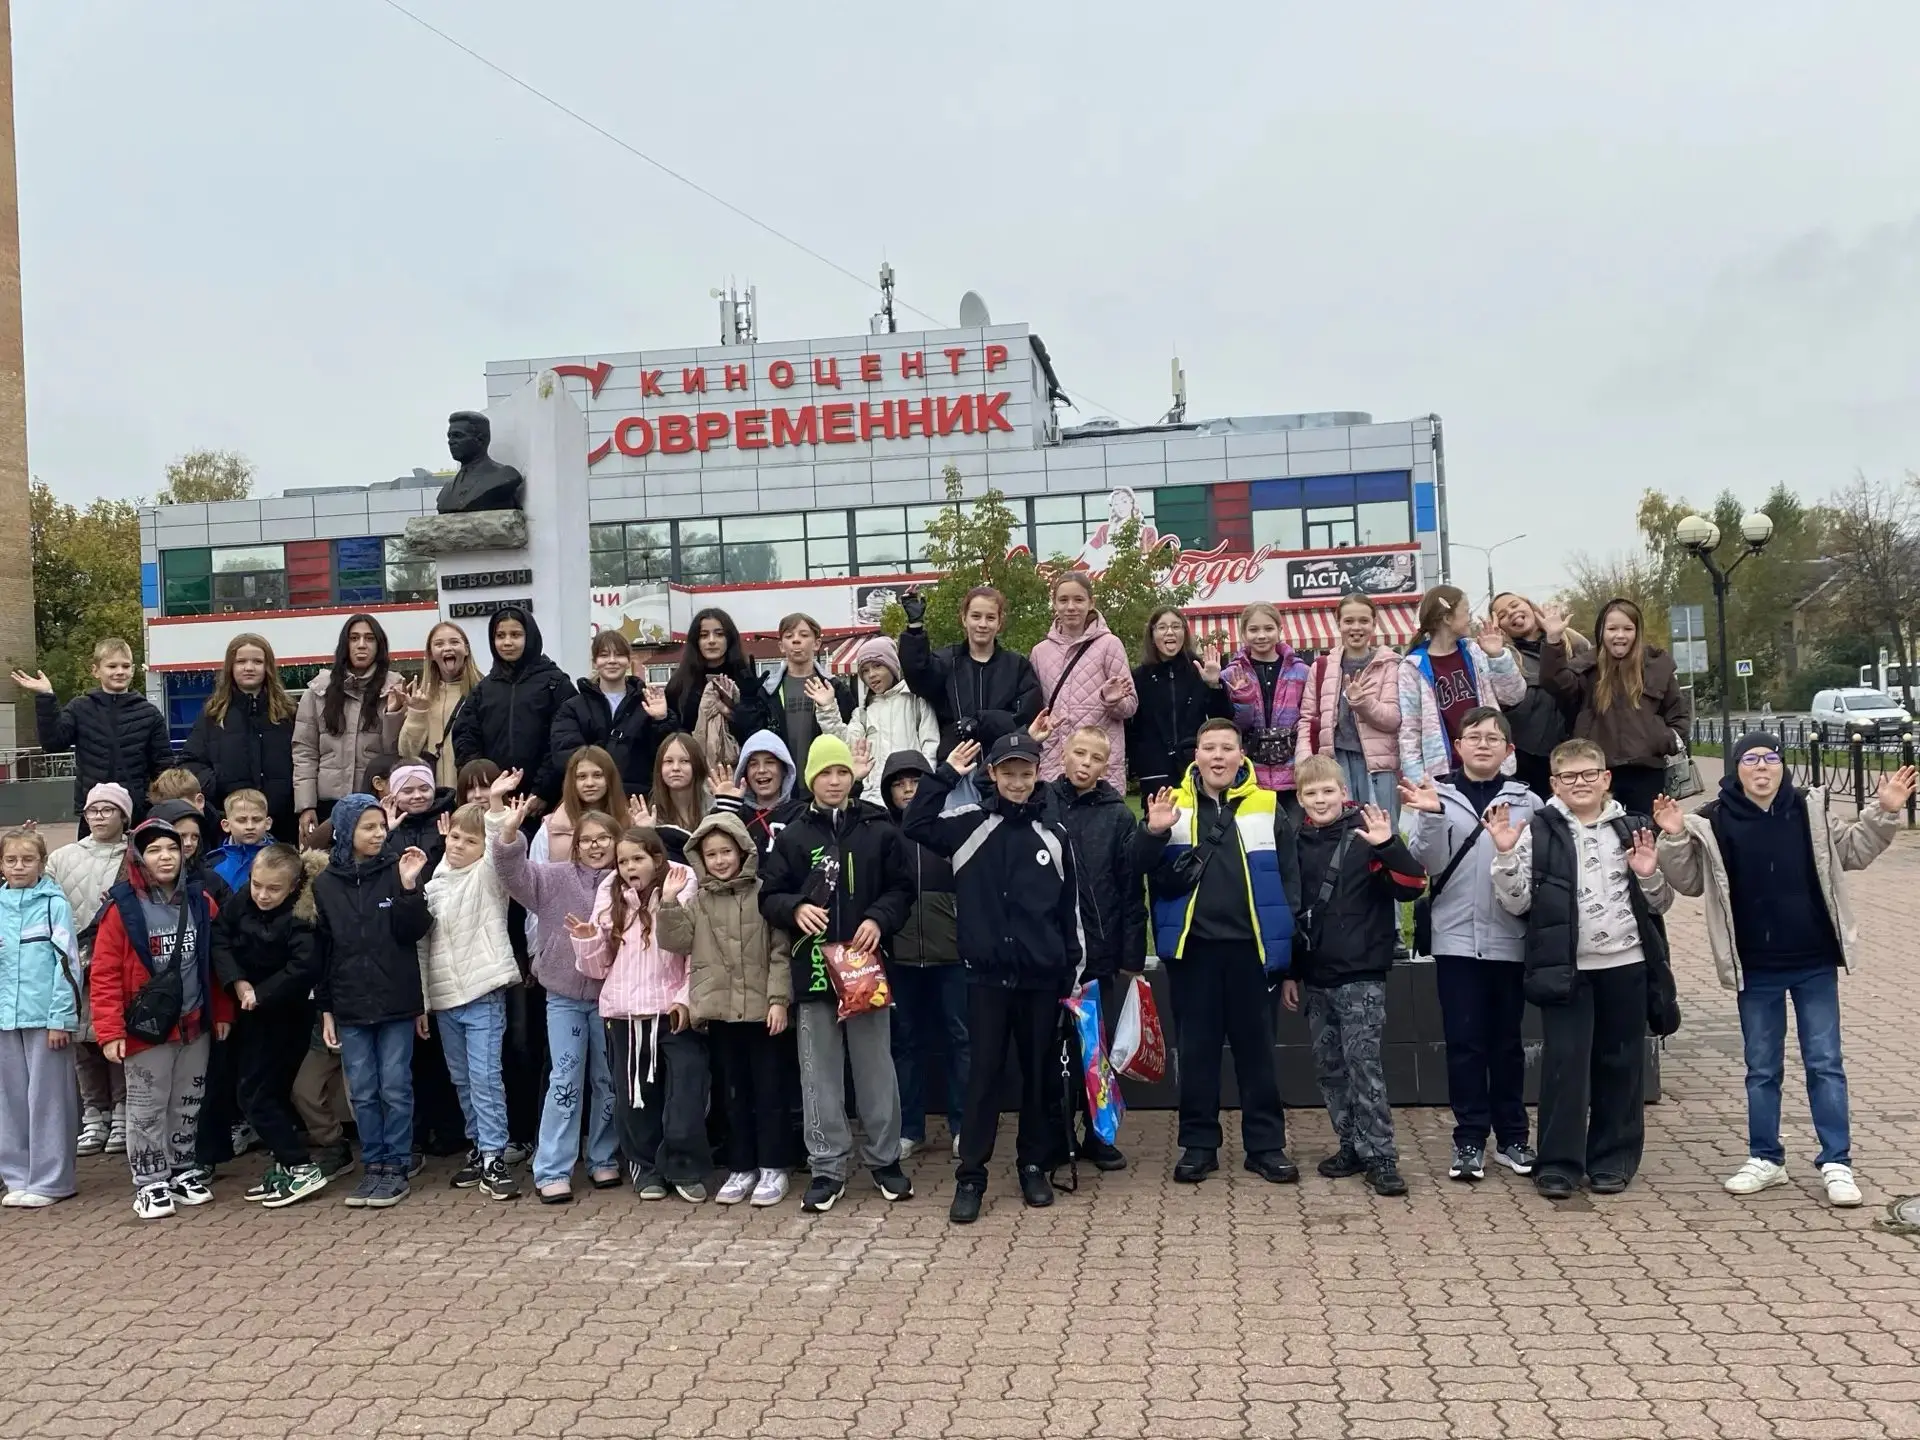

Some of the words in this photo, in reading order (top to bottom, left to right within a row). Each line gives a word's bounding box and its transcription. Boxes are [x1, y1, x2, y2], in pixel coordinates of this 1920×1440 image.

[640, 344, 1010, 398] КИНОЦЕНТР
[445, 570, 527, 589] ТЕВОСЯН
[1292, 571, 1351, 588] ПАСТА
[163, 932, 194, 946] RUES
[163, 942, 195, 955] LITS
